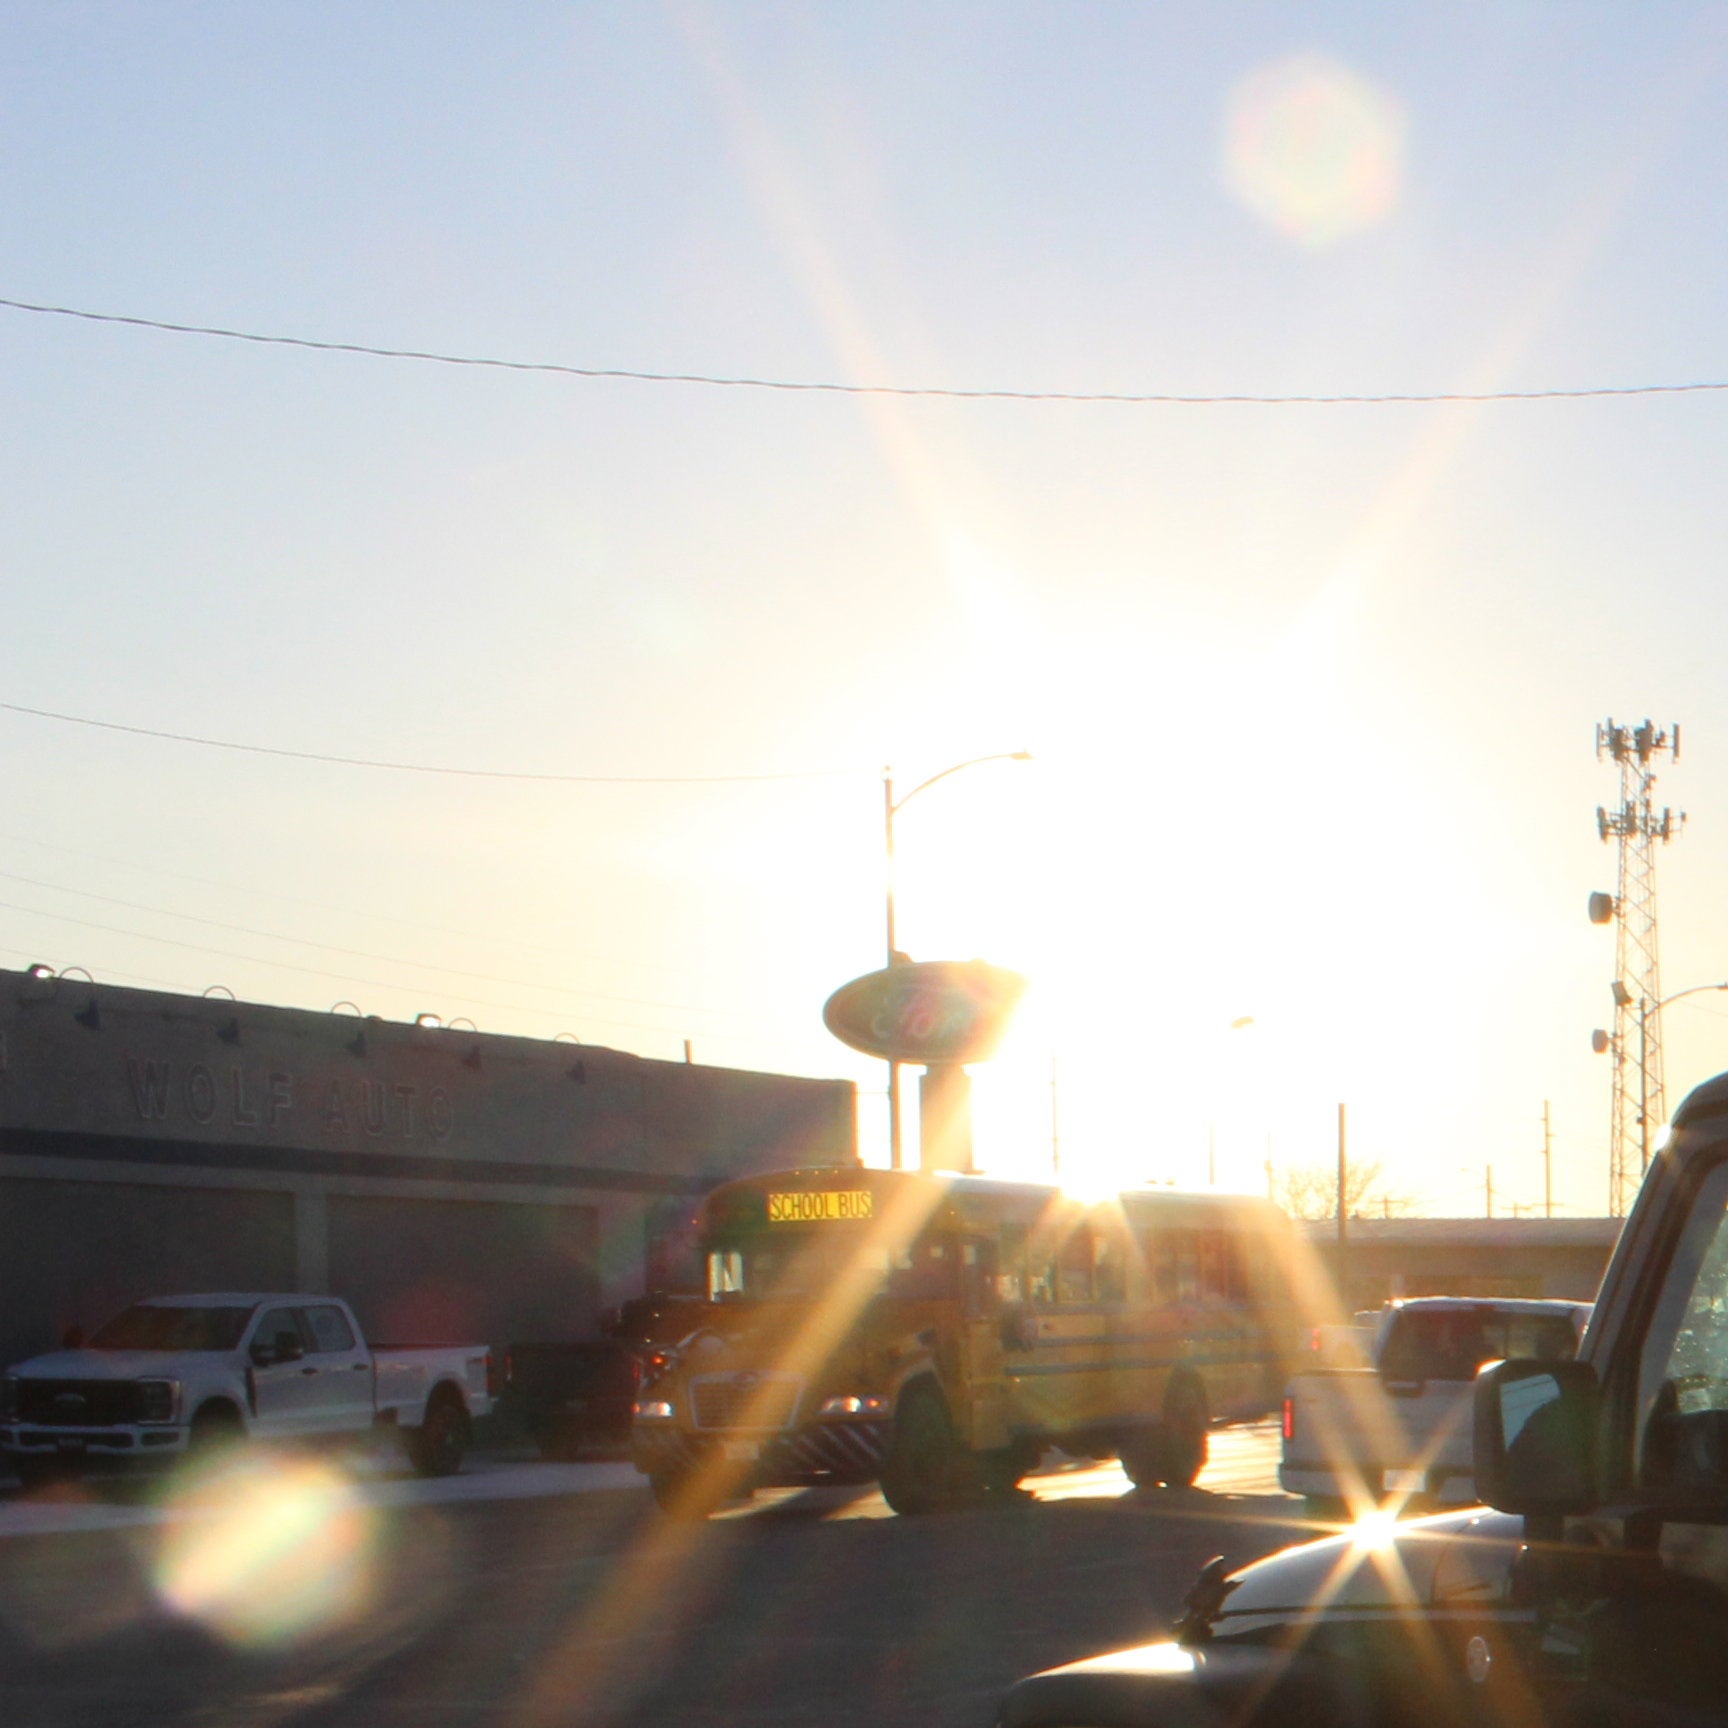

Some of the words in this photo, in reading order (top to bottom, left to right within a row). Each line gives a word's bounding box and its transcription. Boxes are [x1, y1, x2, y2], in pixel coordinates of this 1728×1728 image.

[126, 1056, 294, 1130] WOLF
[320, 1078, 456, 1138] AUTO
[771, 1193, 835, 1220] SCHOOL
[839, 1191, 871, 1217] BUS
